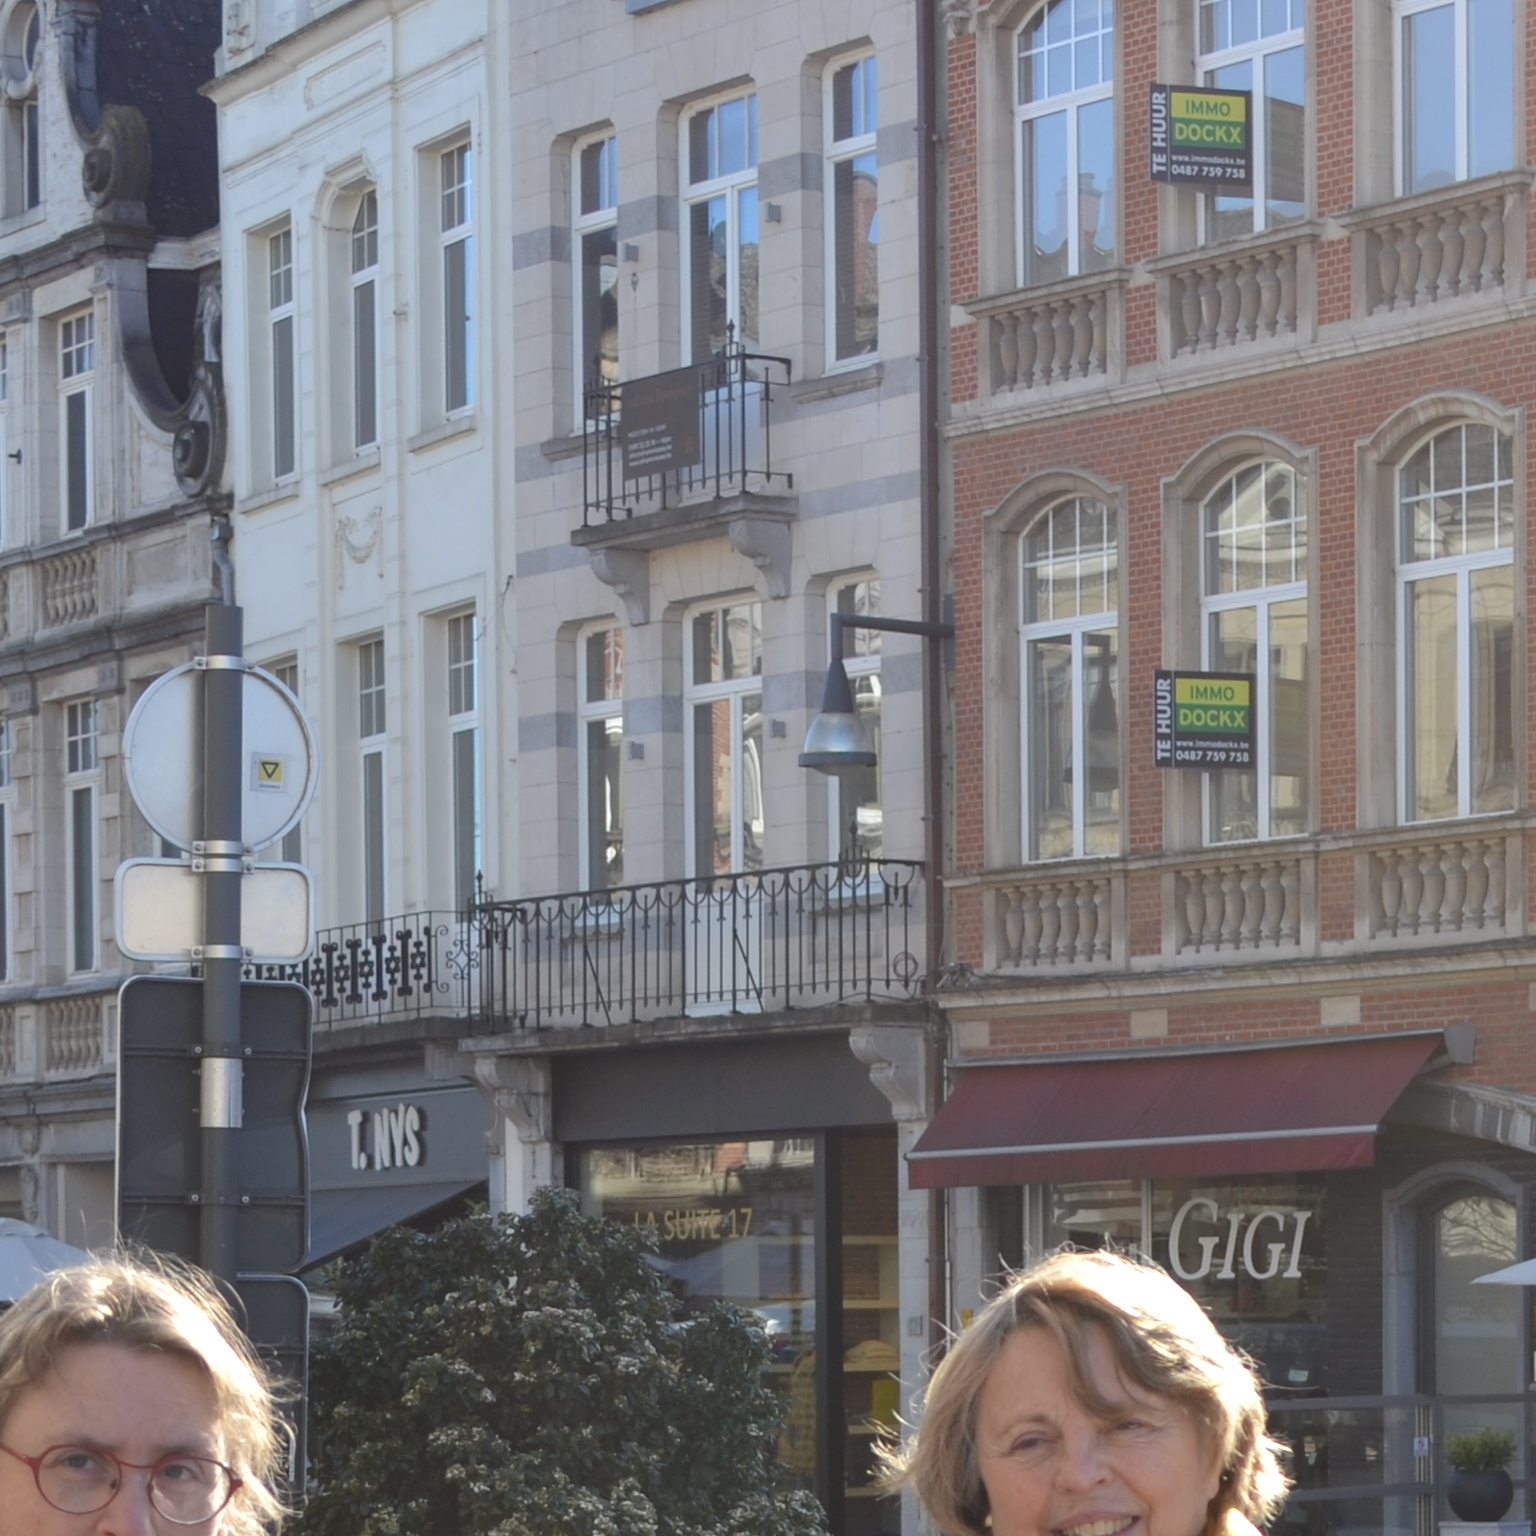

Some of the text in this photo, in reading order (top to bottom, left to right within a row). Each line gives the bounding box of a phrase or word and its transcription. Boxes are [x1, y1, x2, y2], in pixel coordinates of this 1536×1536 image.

[1185, 100, 1231, 117] IMMO
[1152, 92, 1167, 174] TE HUUR
[1174, 123, 1242, 144] DOCKX
[1171, 164, 1199, 175] 0487
[1202, 166, 1224, 178] 759
[1190, 685, 1235, 701] IMMO
[1156, 678, 1171, 760] TE HUUR
[1179, 709, 1245, 728] DOCKX
[1175, 750, 1203, 761] 0487
[1205, 751, 1227, 762] 759
[374, 1102, 421, 1171] NYS
[664, 1209, 722, 1240] SUITE
[728, 1207, 753, 1239] 17
[1168, 1197, 1313, 1281] GIGI
